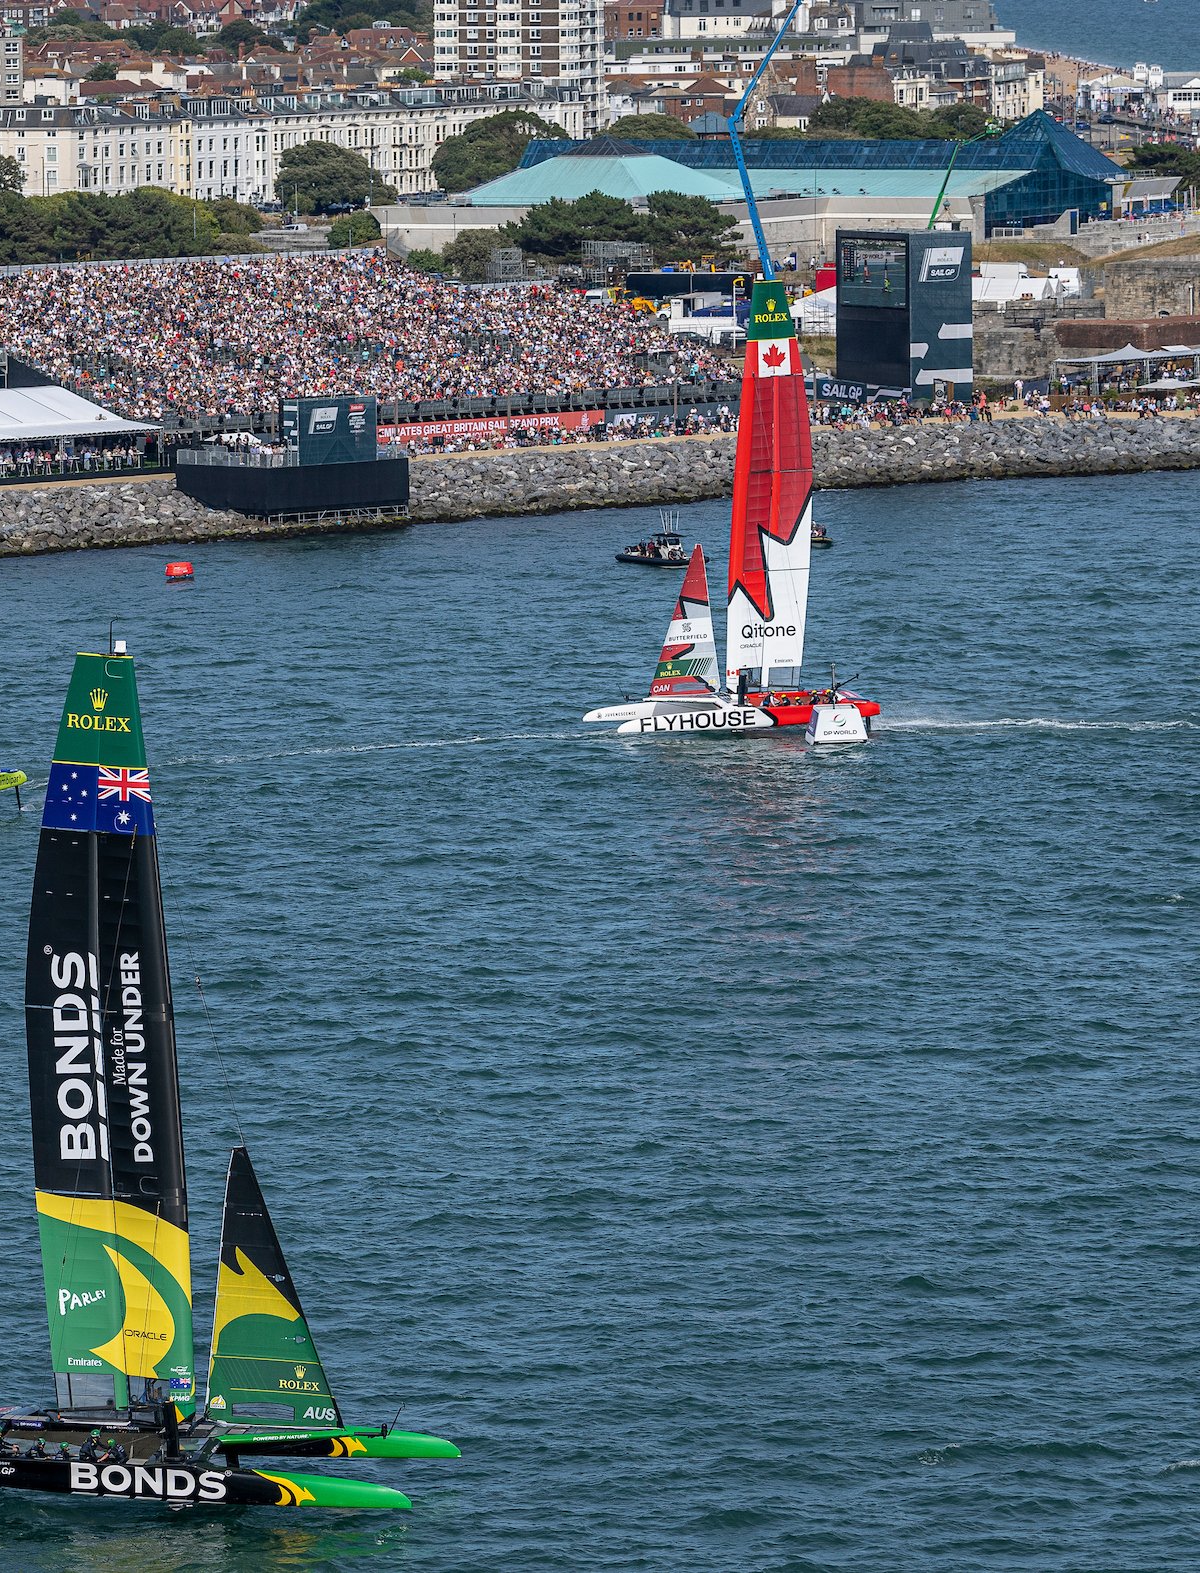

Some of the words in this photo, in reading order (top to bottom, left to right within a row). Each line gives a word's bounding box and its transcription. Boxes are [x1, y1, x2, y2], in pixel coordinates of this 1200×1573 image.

[754, 312, 788, 323] ROLEX
[423, 424, 452, 434] GREAT
[454, 421, 487, 432] BRITAIN
[488, 418, 507, 430] SAIL
[669, 633, 708, 641] BUTTERFIELD
[741, 623, 796, 639] Qitone
[653, 684, 670, 692] CAN
[66, 713, 132, 733] ROLEX
[640, 710, 756, 733] FLYHOUSE
[119, 952, 146, 1053] UNDER
[110, 1027, 123, 1046] for
[111, 1049, 127, 1086] Made
[127, 1062, 154, 1163] DOWN
[124, 1329, 167, 1341] ORACLE
[67, 1357, 103, 1367] Emirates
[278, 1379, 320, 1391] ROLEX
[302, 1406, 336, 1421] AUS
